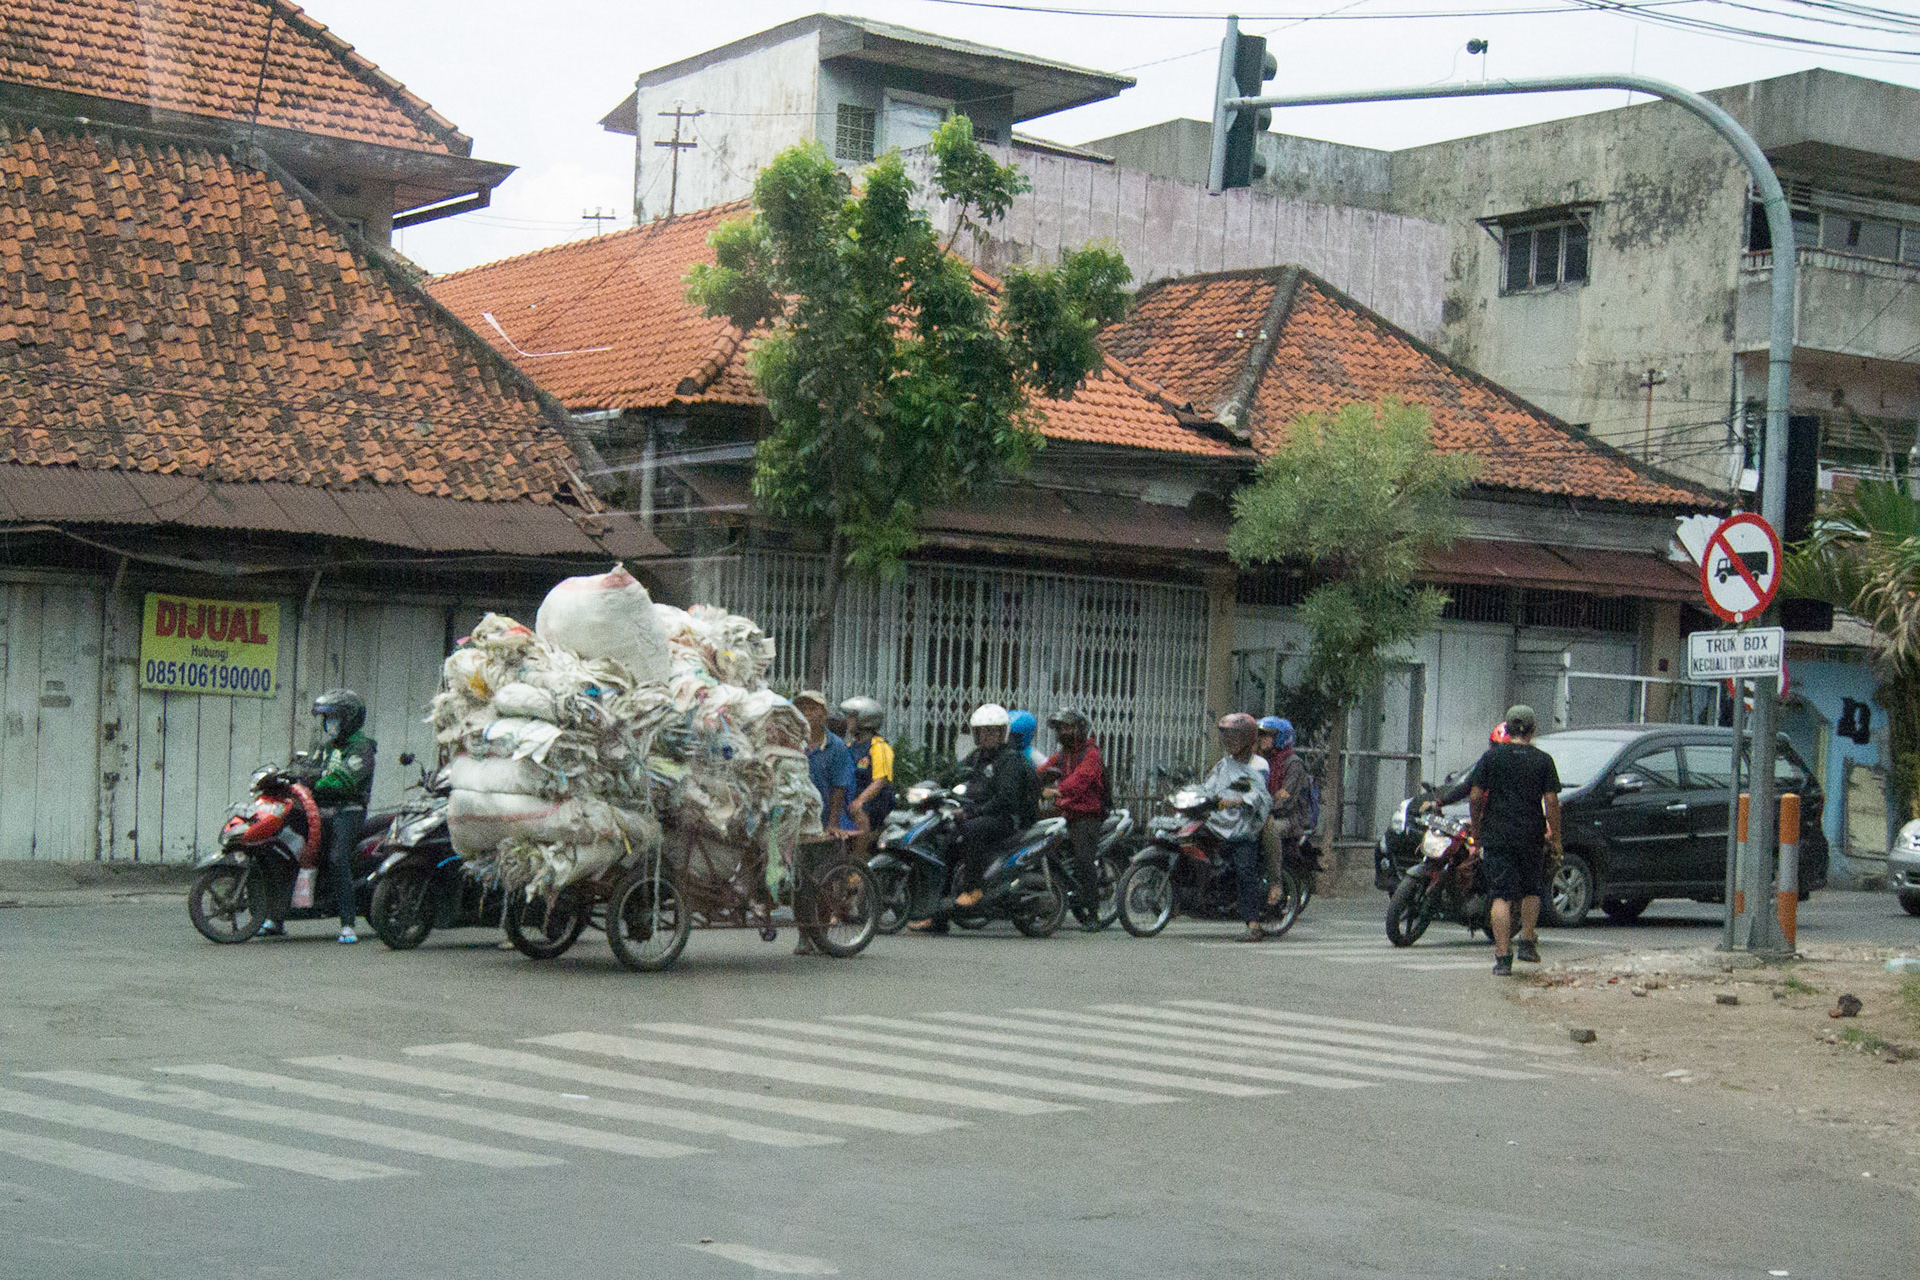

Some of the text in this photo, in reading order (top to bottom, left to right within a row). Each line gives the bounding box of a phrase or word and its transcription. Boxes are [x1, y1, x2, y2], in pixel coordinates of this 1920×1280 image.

[155, 599, 268, 644] DIJUAL
[191, 644, 229, 662] Hubungi
[1706, 636, 1769, 653] TRUK BOX
[1693, 657, 1727, 671] KECUALI
[146, 658, 271, 692] 085106190000
